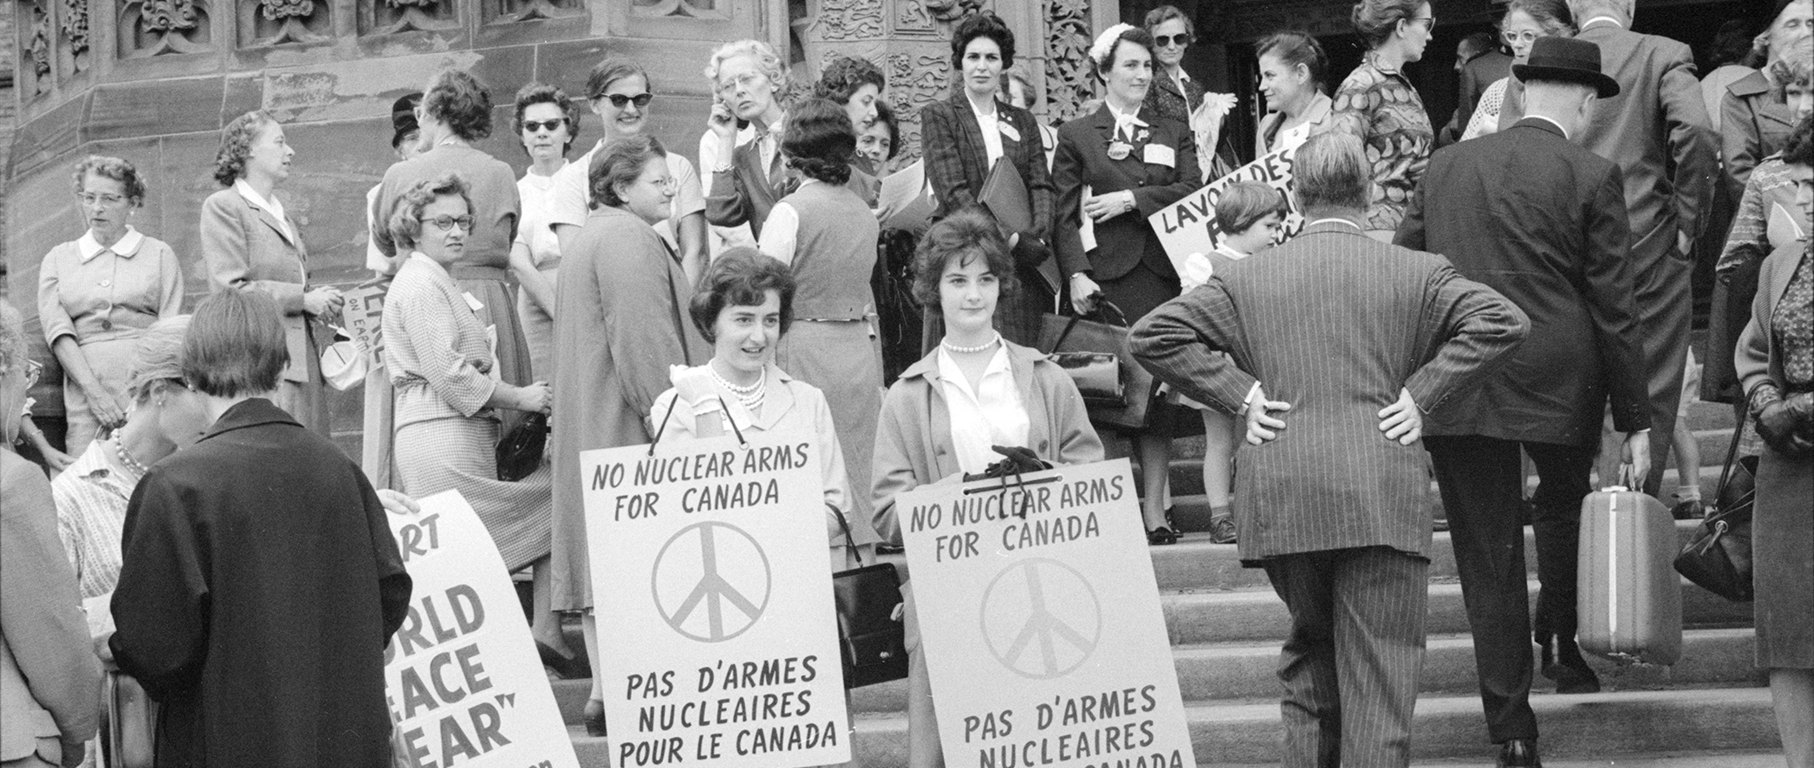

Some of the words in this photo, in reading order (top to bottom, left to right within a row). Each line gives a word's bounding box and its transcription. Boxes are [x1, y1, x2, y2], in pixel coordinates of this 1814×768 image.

[1250, 149, 1293, 182] DES
[349, 298, 360, 311] ON
[592, 463, 625, 490] NO
[634, 451, 735, 486] NUCLEAR
[743, 443, 809, 474] ARMS
[614, 492, 659, 521] FOR
[682, 478, 779, 513] CANADA
[910, 503, 941, 533] NO
[952, 487, 1051, 526] NUCLEAR
[1060, 475, 1123, 507] ARMS
[935, 531, 979, 562] FOR
[1002, 511, 1100, 551] CANADA
[384, 584, 485, 666] RLD
[385, 643, 493, 722] ACE
[626, 670, 675, 700] PAS
[698, 655, 818, 693] D'ARMES
[638, 690, 812, 732] NUCLEAIRES
[964, 709, 1013, 743] PAS
[1036, 684, 1157, 730] D'ARMES
[620, 736, 684, 768] POUR
[697, 733, 722, 760] LE
[736, 721, 837, 755] CANADA
[980, 719, 1154, 768] NUCLEAIRES
